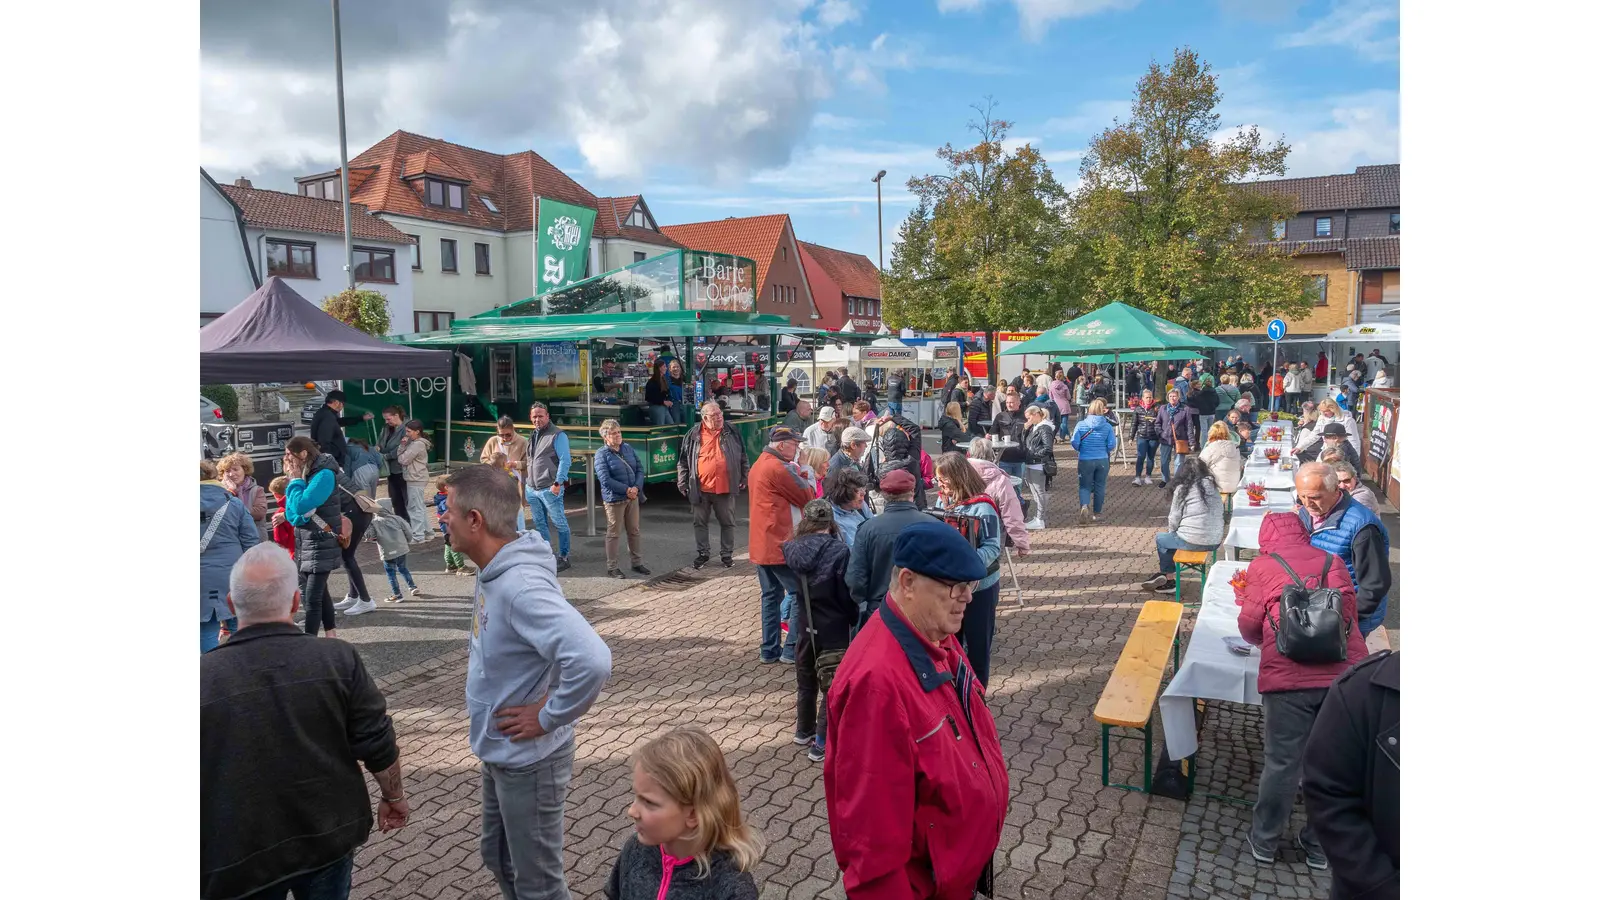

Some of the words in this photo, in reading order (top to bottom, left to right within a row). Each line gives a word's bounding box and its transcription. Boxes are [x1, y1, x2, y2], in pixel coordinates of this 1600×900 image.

[702, 256, 744, 282] Barre
[696, 275, 753, 310] Lounge
[1063, 328, 1115, 336] Barre
[708, 355, 739, 363] 24MX
[793, 351, 812, 359] 24MX
[362, 376, 447, 398] Lounge
[653, 453, 676, 463] Barre
